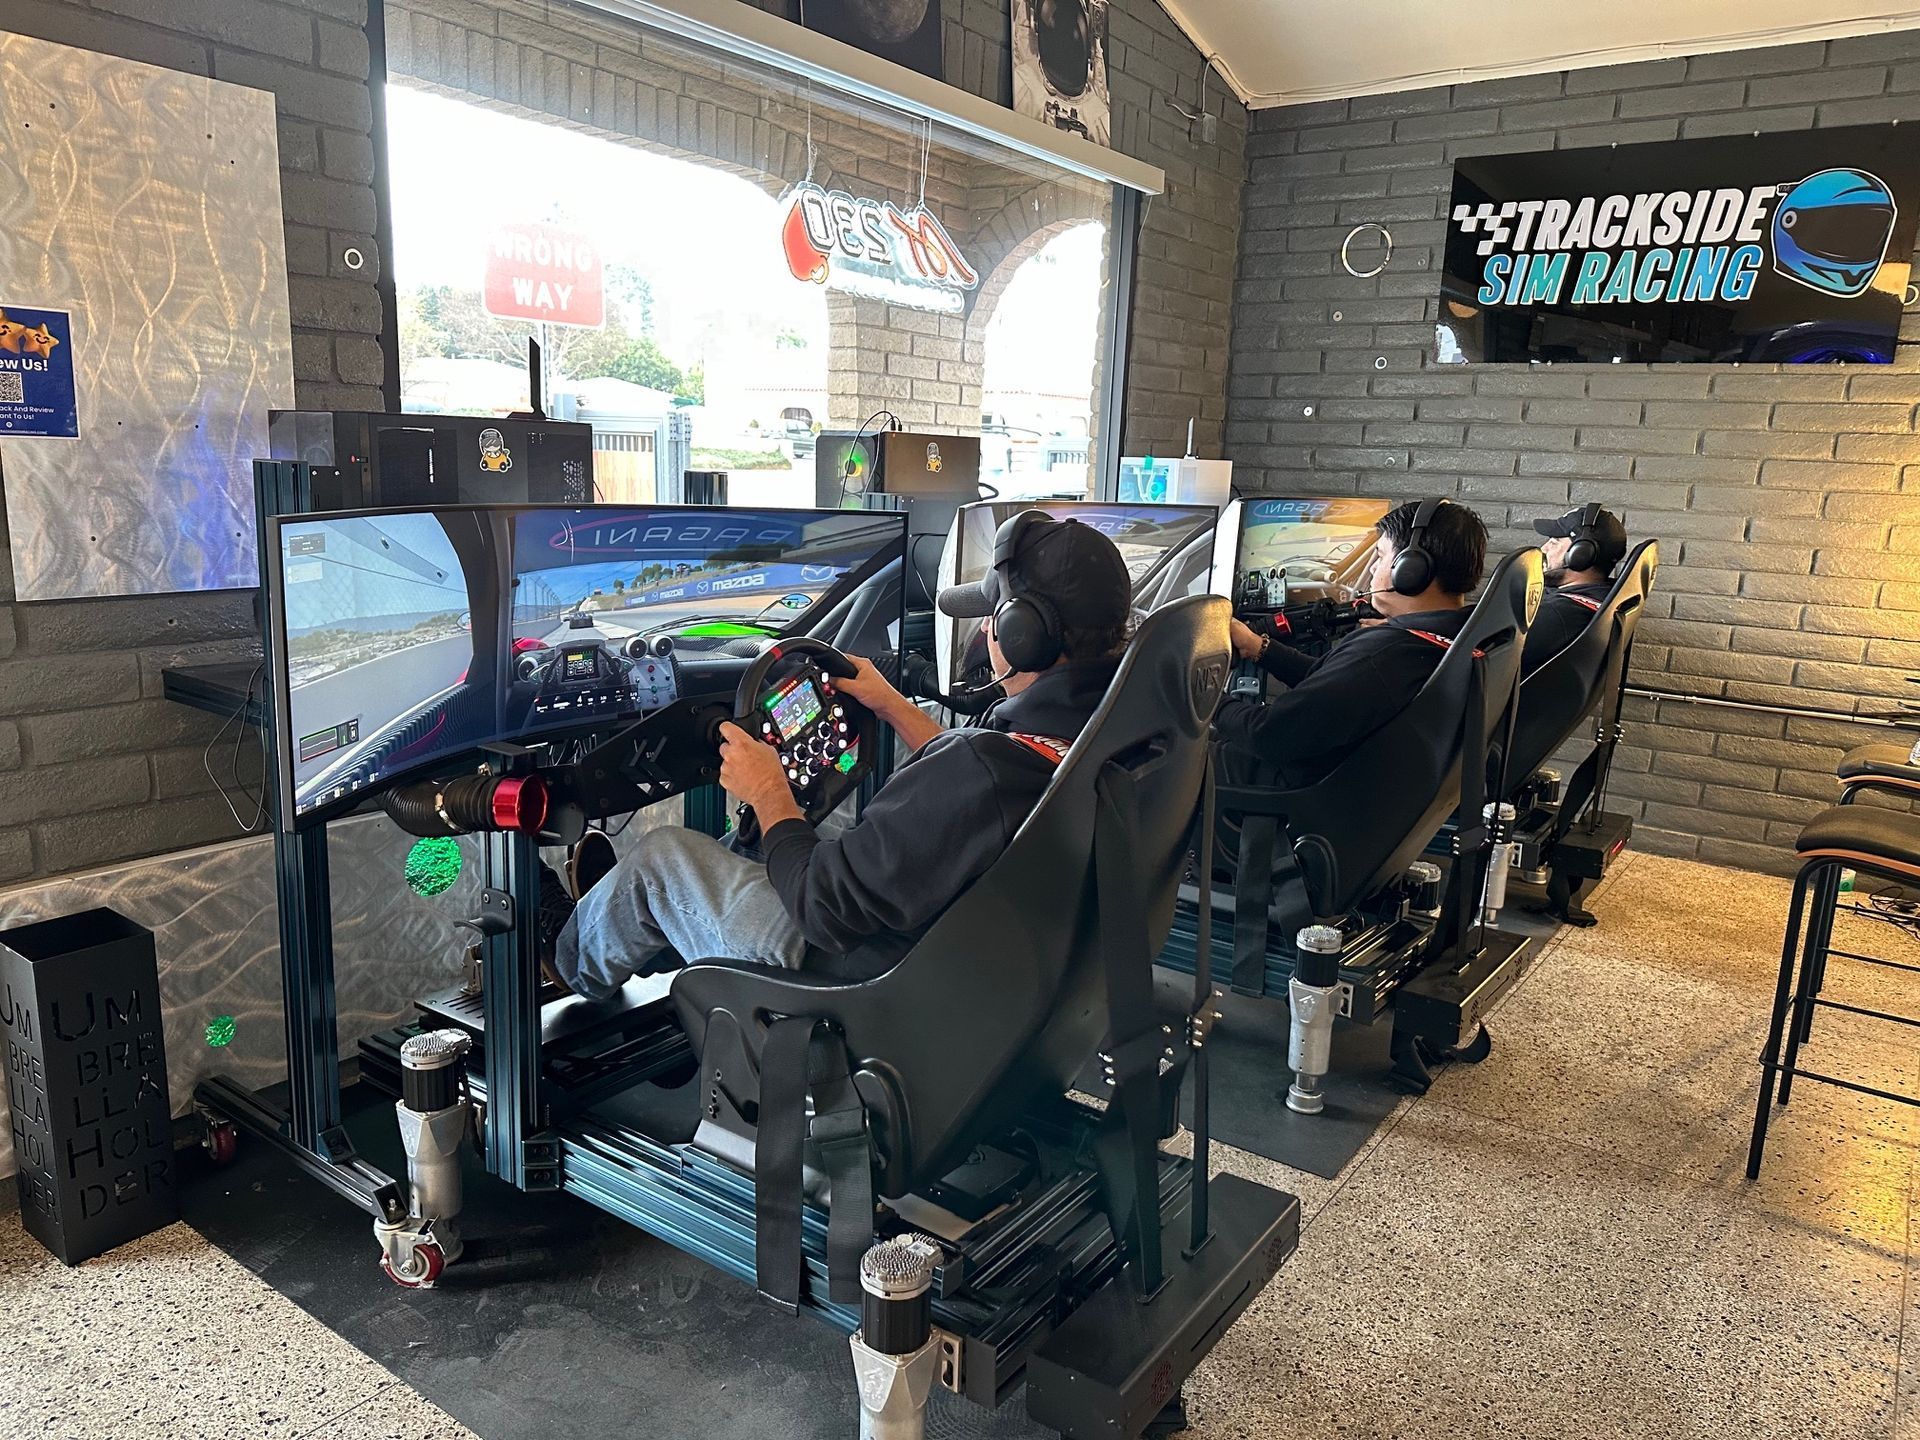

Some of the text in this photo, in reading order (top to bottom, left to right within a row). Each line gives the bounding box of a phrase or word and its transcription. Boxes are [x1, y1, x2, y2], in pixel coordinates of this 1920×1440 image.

[1513, 186, 1777, 251] TRACKSIDE
[491, 231, 593, 272] WRONG
[1478, 245, 1764, 306] SIM RACING
[512, 277, 574, 311] WAY
[22, 358, 48, 372] Us!
[659, 587, 684, 598] mazda
[712, 573, 765, 591] mazda
[792, 703, 802, 717] 3
[0, 984, 34, 1044] UM
[52, 990, 143, 1042] UM
[8, 1039, 44, 1094] BRE
[77, 1032, 158, 1086] BRE
[10, 1076, 49, 1134] LLA
[10, 1112, 53, 1179] HOL
[66, 1119, 163, 1178] HOL
[20, 1164, 59, 1225] DER
[80, 1159, 171, 1219] DER
